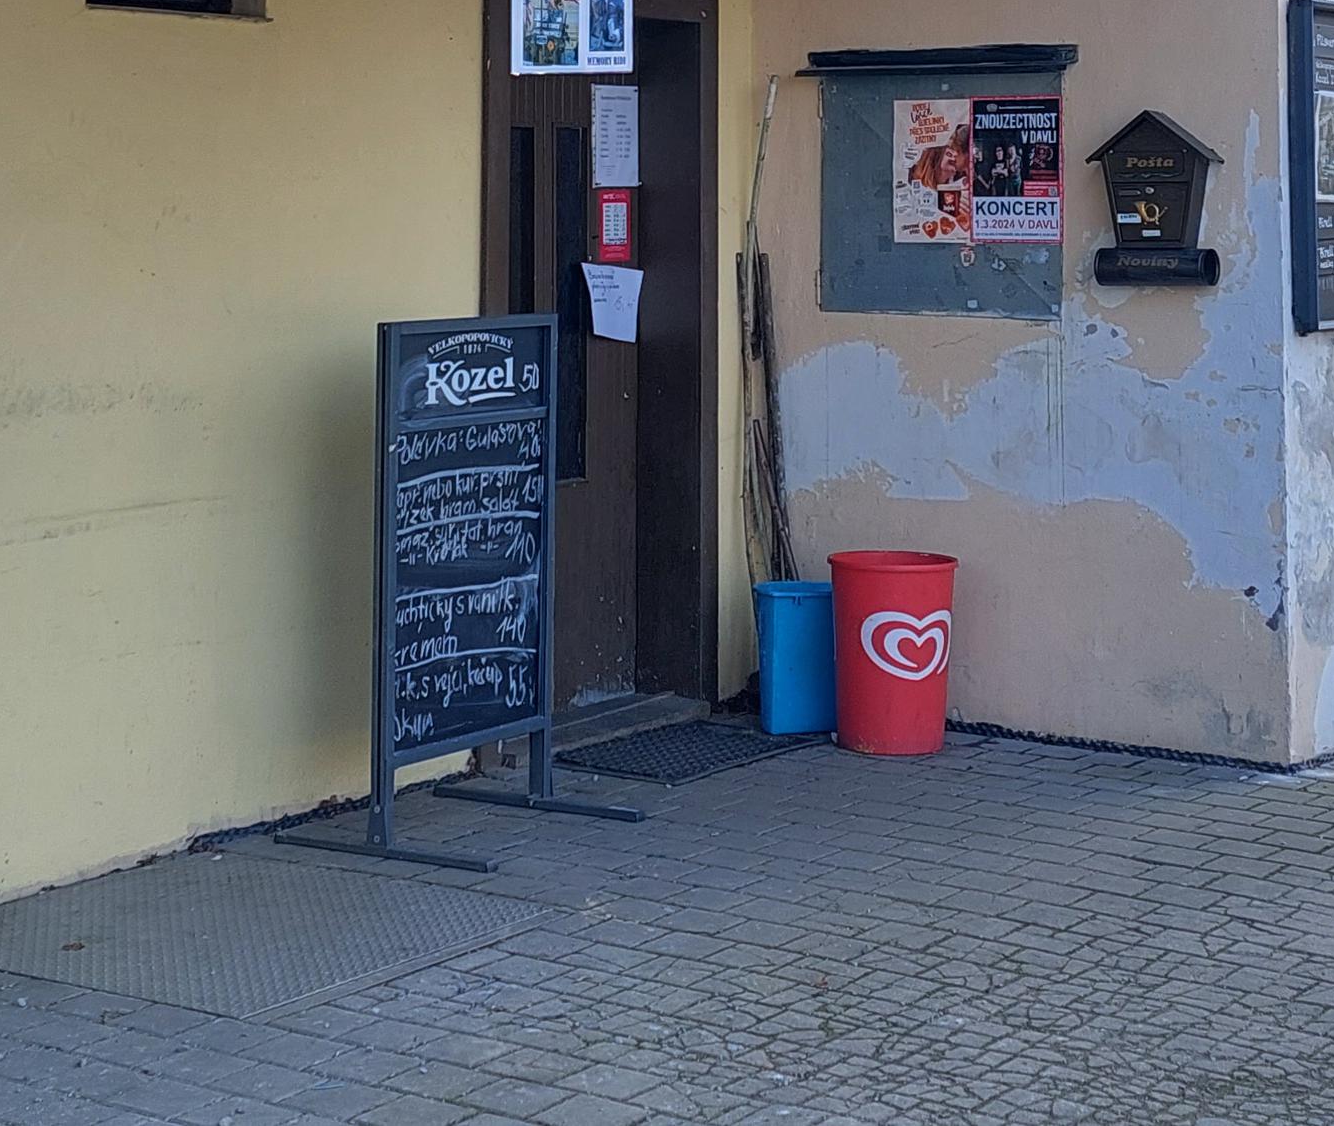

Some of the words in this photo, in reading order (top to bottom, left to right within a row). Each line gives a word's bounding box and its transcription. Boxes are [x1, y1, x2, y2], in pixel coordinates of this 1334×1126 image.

[974, 113, 1058, 130] ZNOUZECTNOST
[1021, 131, 1029, 144] V
[1029, 130, 1057, 144] DAVLI
[1126, 156, 1175, 168] Pošta
[975, 201, 1058, 216] KONCERT
[975, 219, 1015, 230] 1.3.2024
[1018, 219, 1025, 229] V
[1028, 219, 1059, 230] DAVLI
[1117, 256, 1179, 269] Noviny
[428, 332, 514, 355] VELKOPOPOVICKÝ
[464, 344, 482, 354] 1874
[424, 356, 516, 406] Kozel
